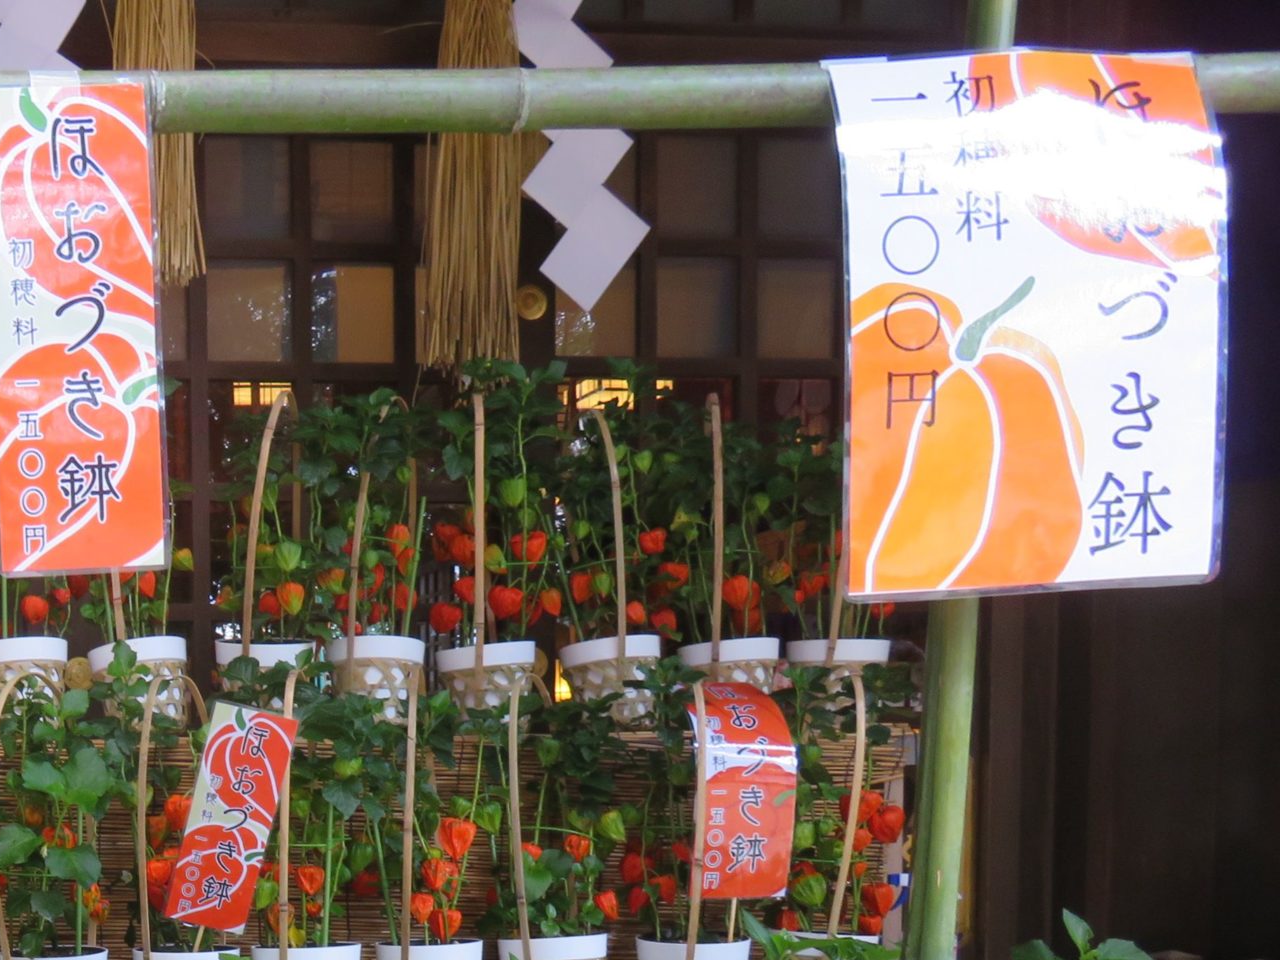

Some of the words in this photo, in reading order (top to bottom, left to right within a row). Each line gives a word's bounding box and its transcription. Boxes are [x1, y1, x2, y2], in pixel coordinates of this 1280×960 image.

[7, 239, 39, 346] 初穂料
[50, 116, 121, 524] ほおづき鉢
[15, 379, 47, 554] 一五〇〇円
[198, 725, 270, 909] ほおづき鉢
